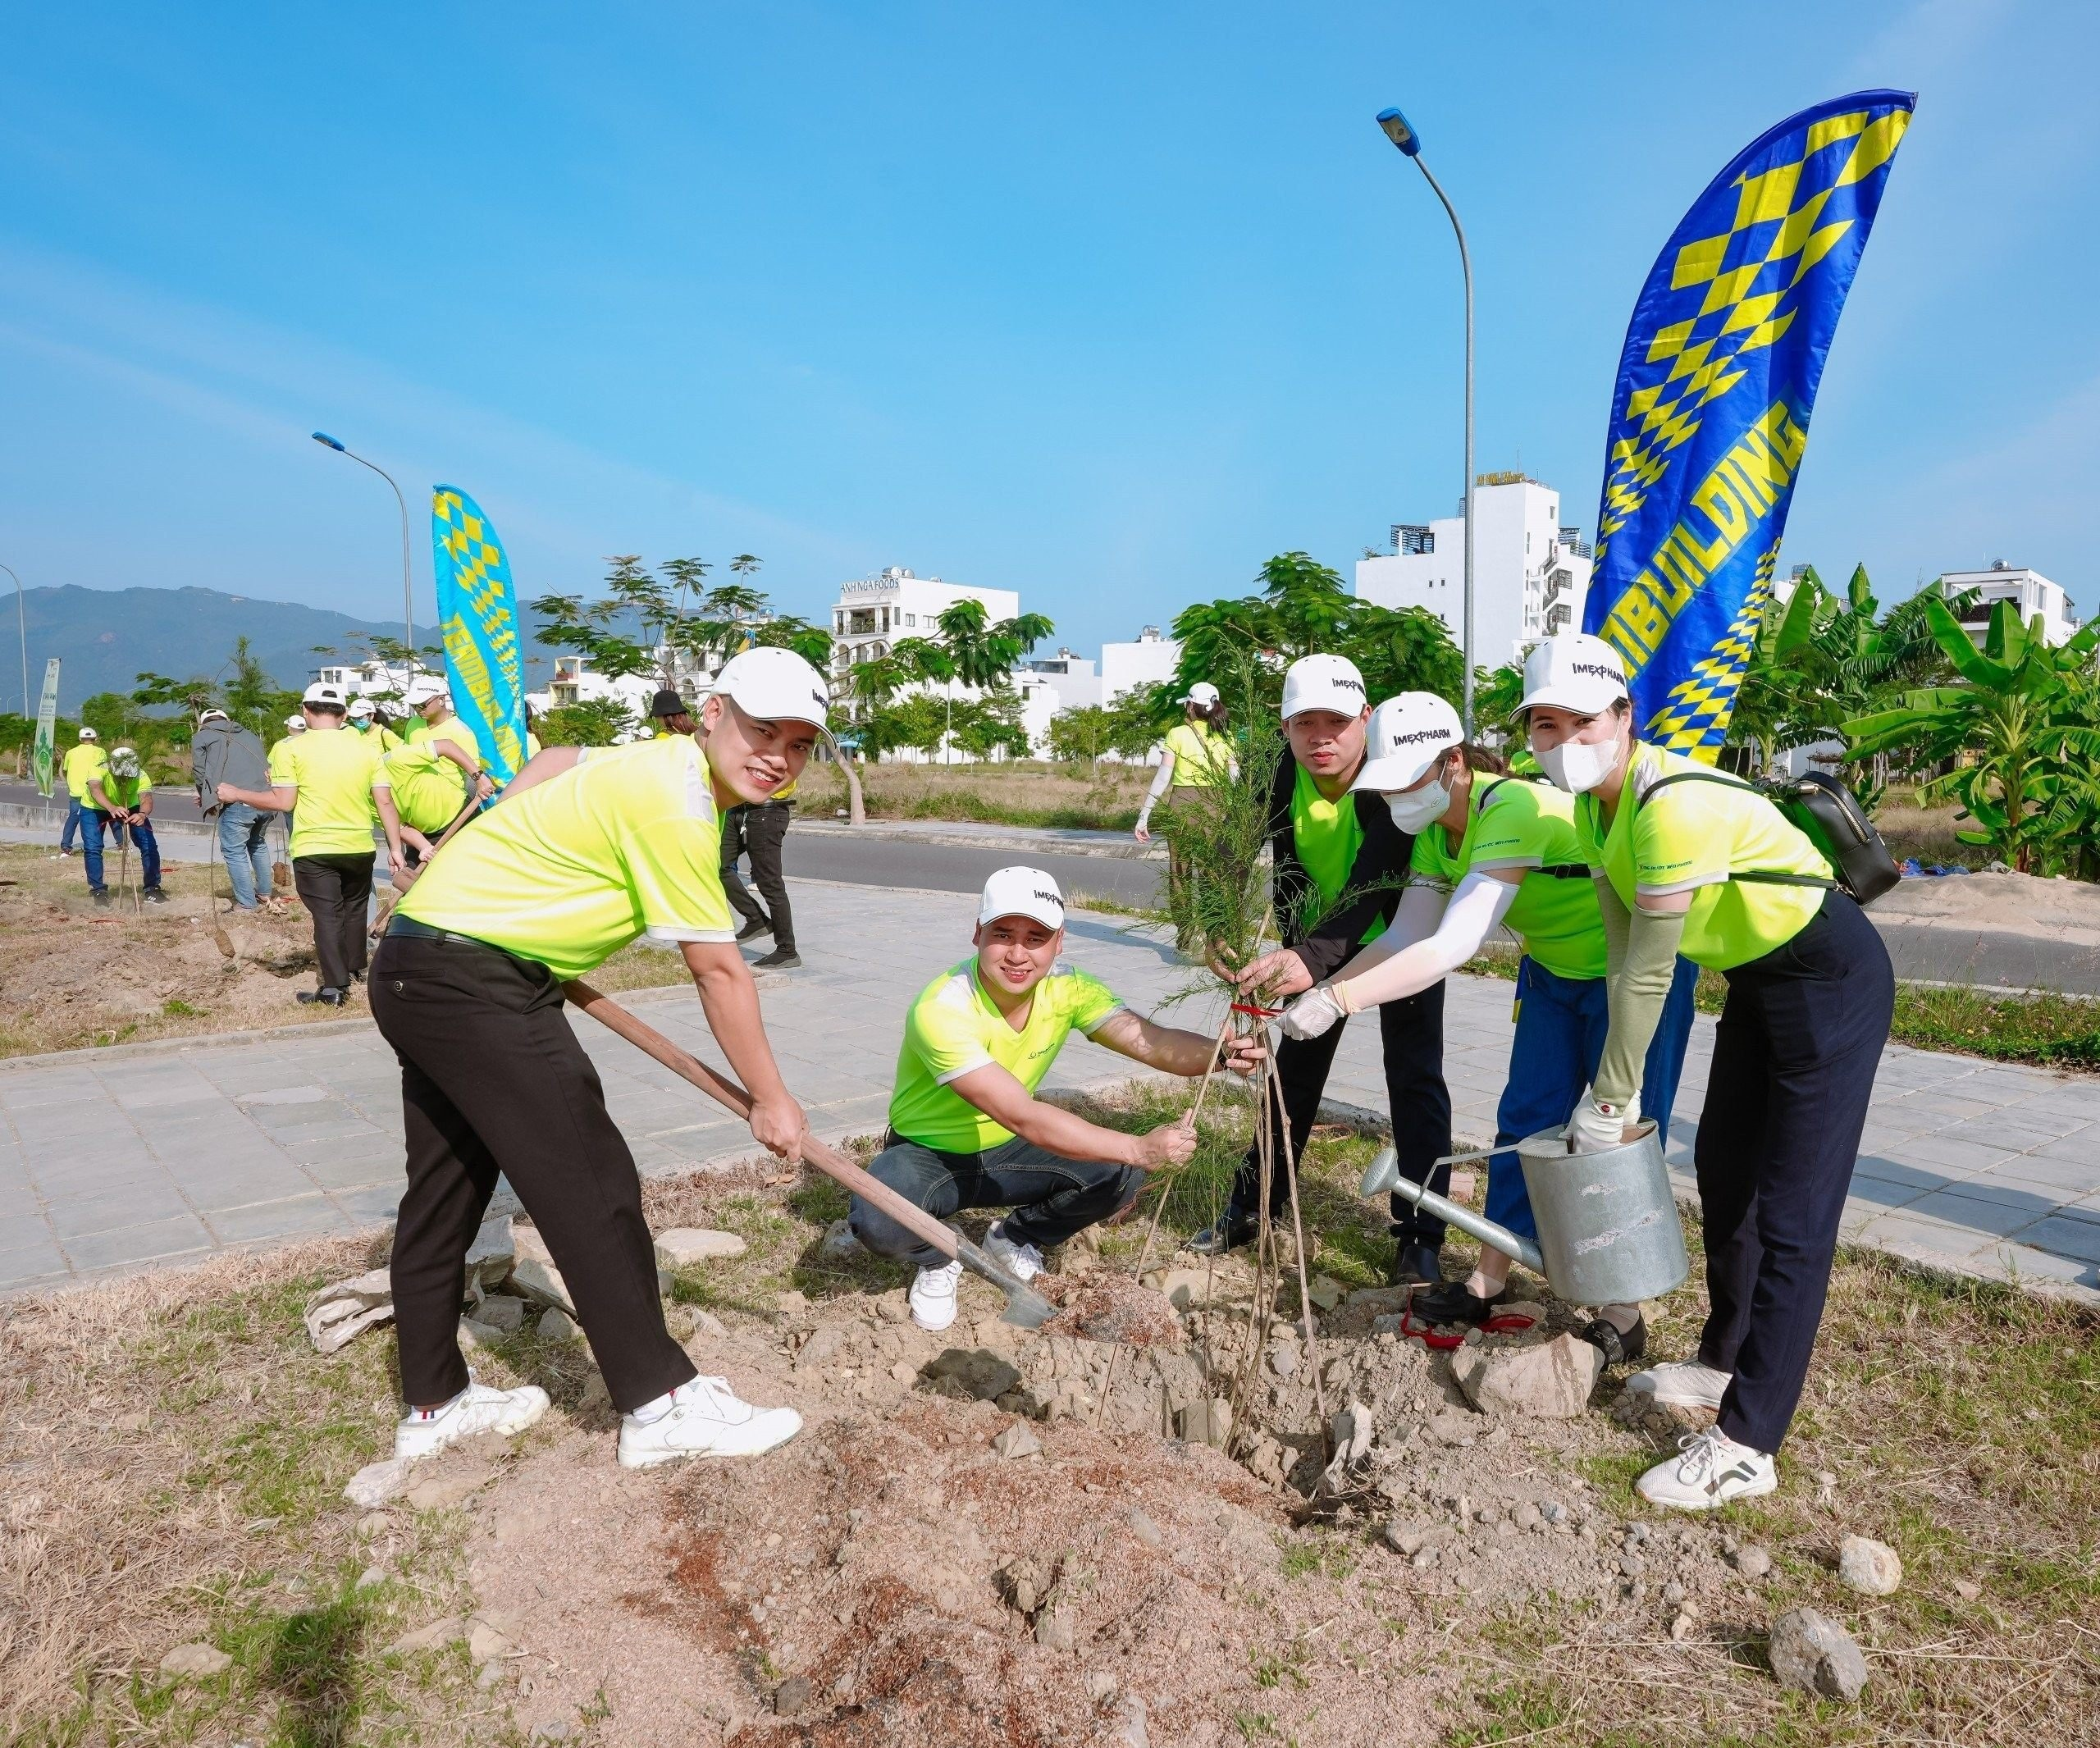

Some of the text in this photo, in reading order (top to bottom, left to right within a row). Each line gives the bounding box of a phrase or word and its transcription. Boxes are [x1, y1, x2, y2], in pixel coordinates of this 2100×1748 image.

[841, 577, 899, 593] ANH NGA FOODS
[1393, 728, 1451, 747] IMEXPHARM
